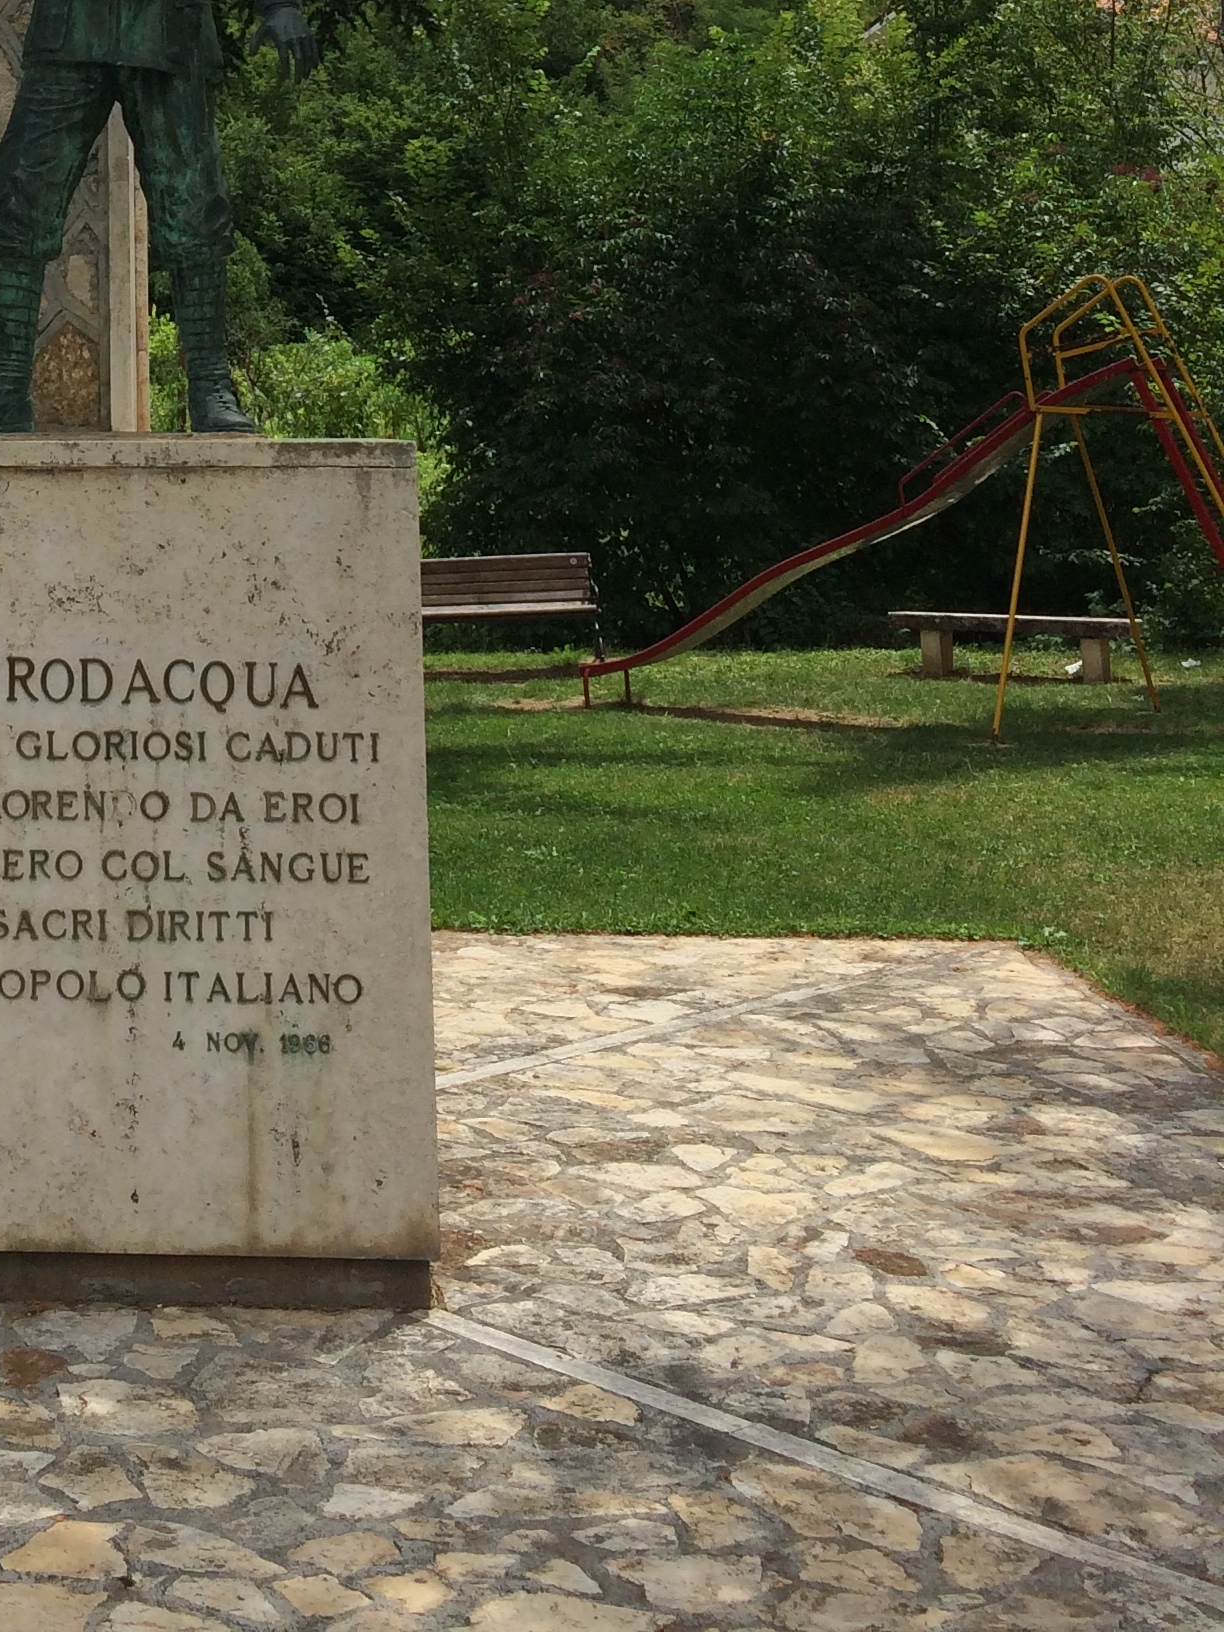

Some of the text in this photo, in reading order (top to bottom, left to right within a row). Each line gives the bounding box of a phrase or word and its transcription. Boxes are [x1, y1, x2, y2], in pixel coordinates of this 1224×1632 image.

[16, 730, 207, 762] GLORIOSI
[226, 731, 380, 763] CADUTI
[190, 792, 245, 824] DA
[264, 792, 361, 824] EROI
[101, 850, 185, 883] COL
[206, 852, 370, 884] SANGUE
[126, 909, 274, 942] DIRITTI
[163, 971, 364, 1005] ITALIANO
[172, 1031, 186, 1051] 4
[206, 1031, 265, 1054] NOV.
